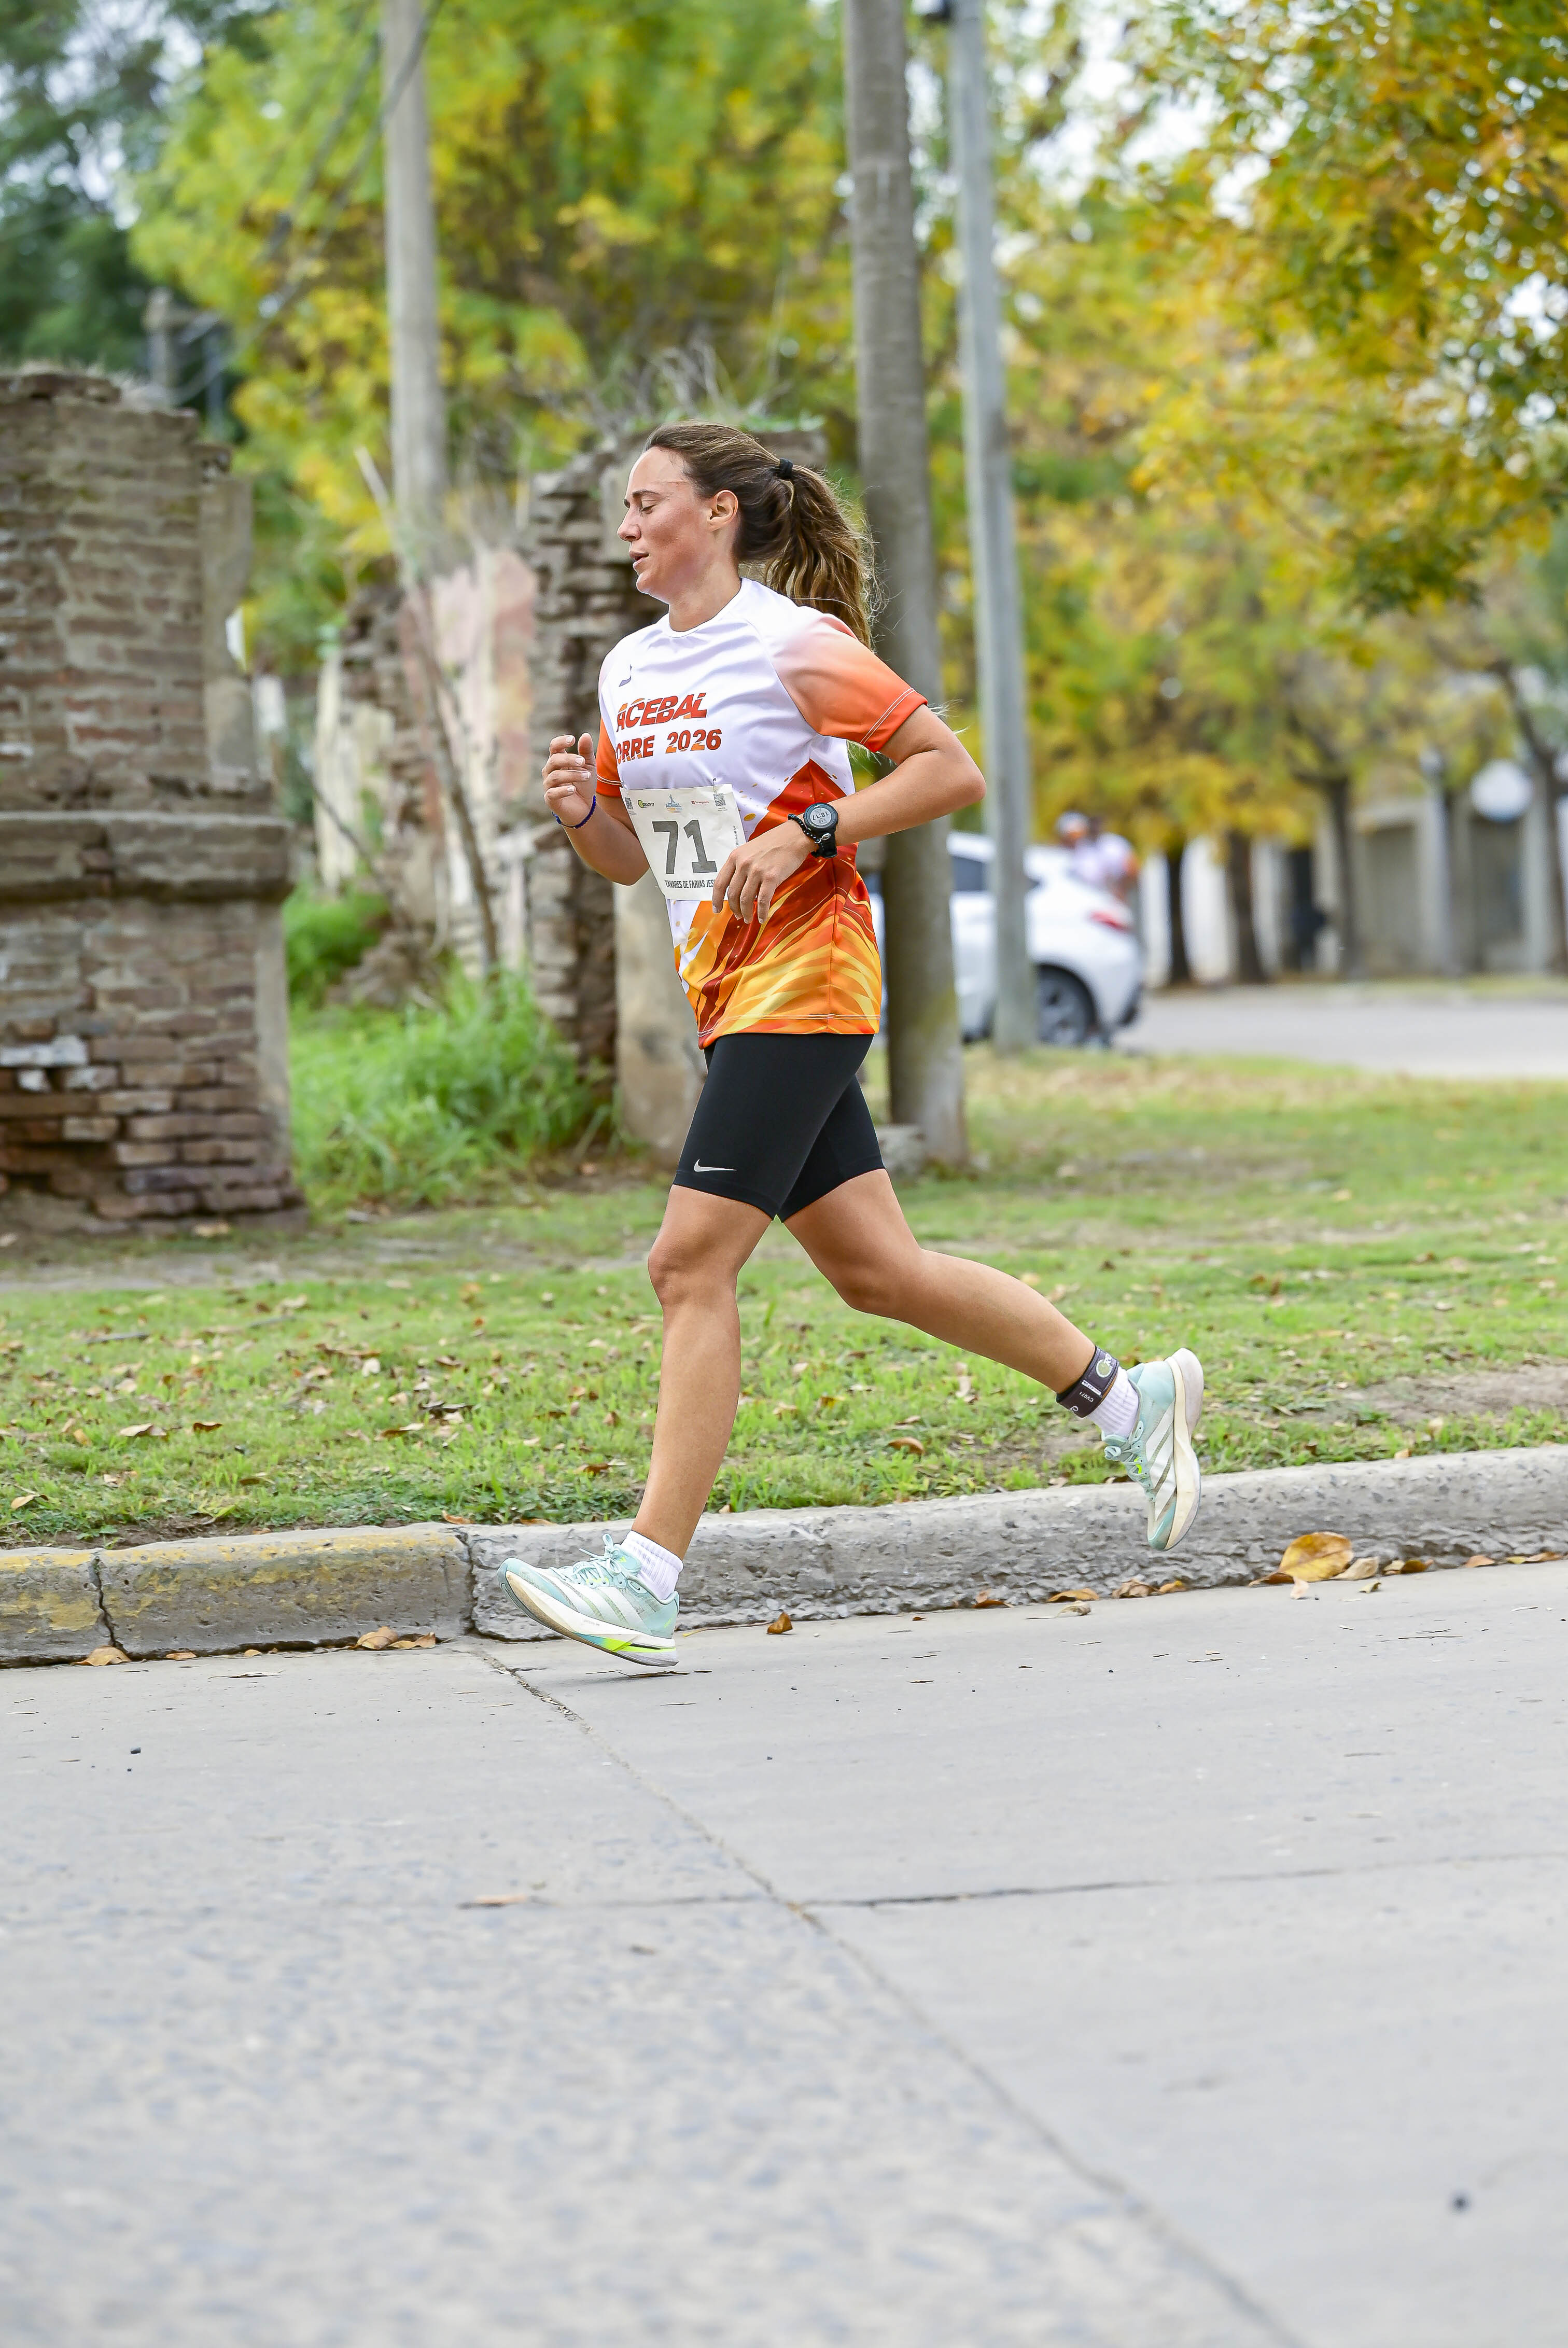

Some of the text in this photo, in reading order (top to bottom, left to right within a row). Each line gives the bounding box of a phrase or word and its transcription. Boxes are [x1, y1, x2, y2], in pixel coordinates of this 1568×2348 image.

[616, 693, 707, 732] ACEBAL
[615, 729, 722, 764] ORRE 2026
[813, 812, 829, 820] 18:17
[652, 819, 718, 874] 71
[1079, 1391, 1094, 1402] CV071
